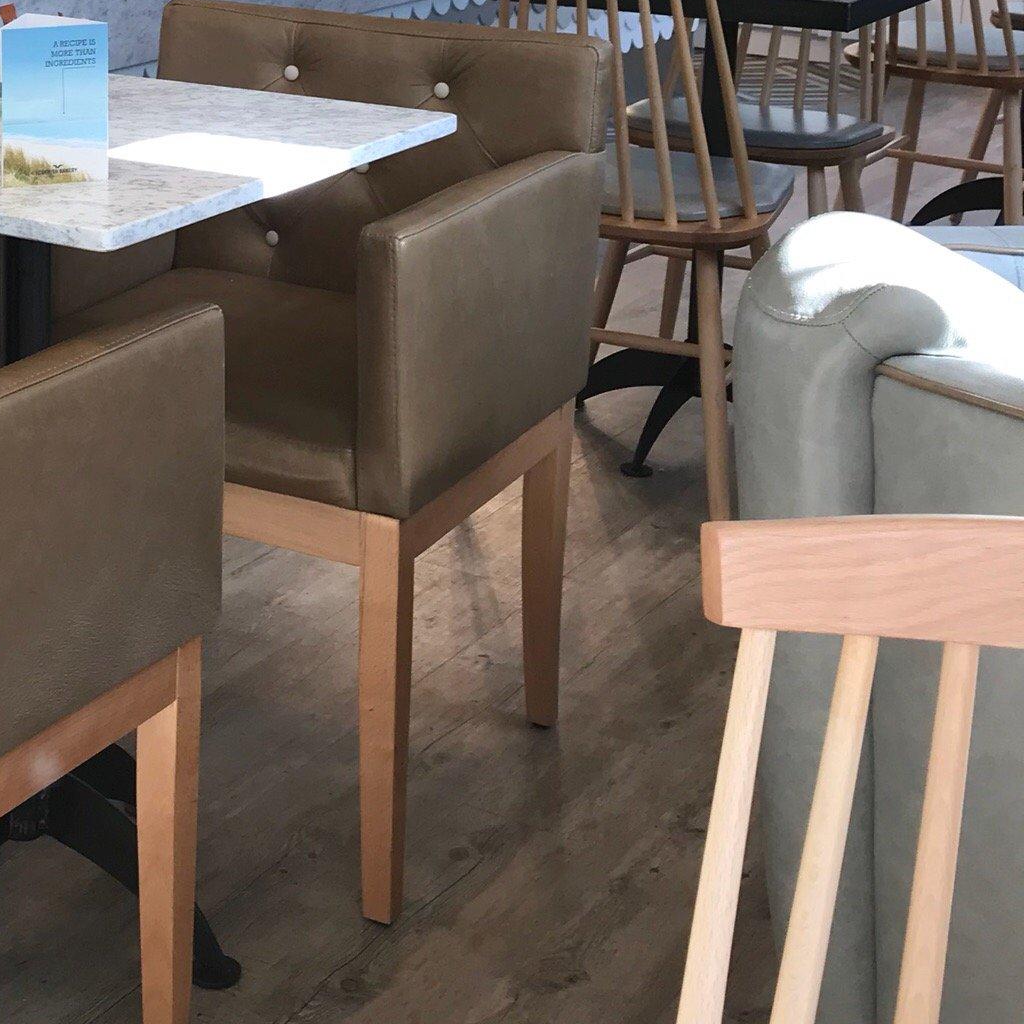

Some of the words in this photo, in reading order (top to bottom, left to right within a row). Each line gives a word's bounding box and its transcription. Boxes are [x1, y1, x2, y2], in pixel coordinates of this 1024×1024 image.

[59, 39, 87, 47] RECIPE
[89, 38, 96, 46] IS
[51, 49, 73, 57] MORE
[75, 48, 96, 56] THAN
[45, 58, 96, 67] INGREDIENTS
